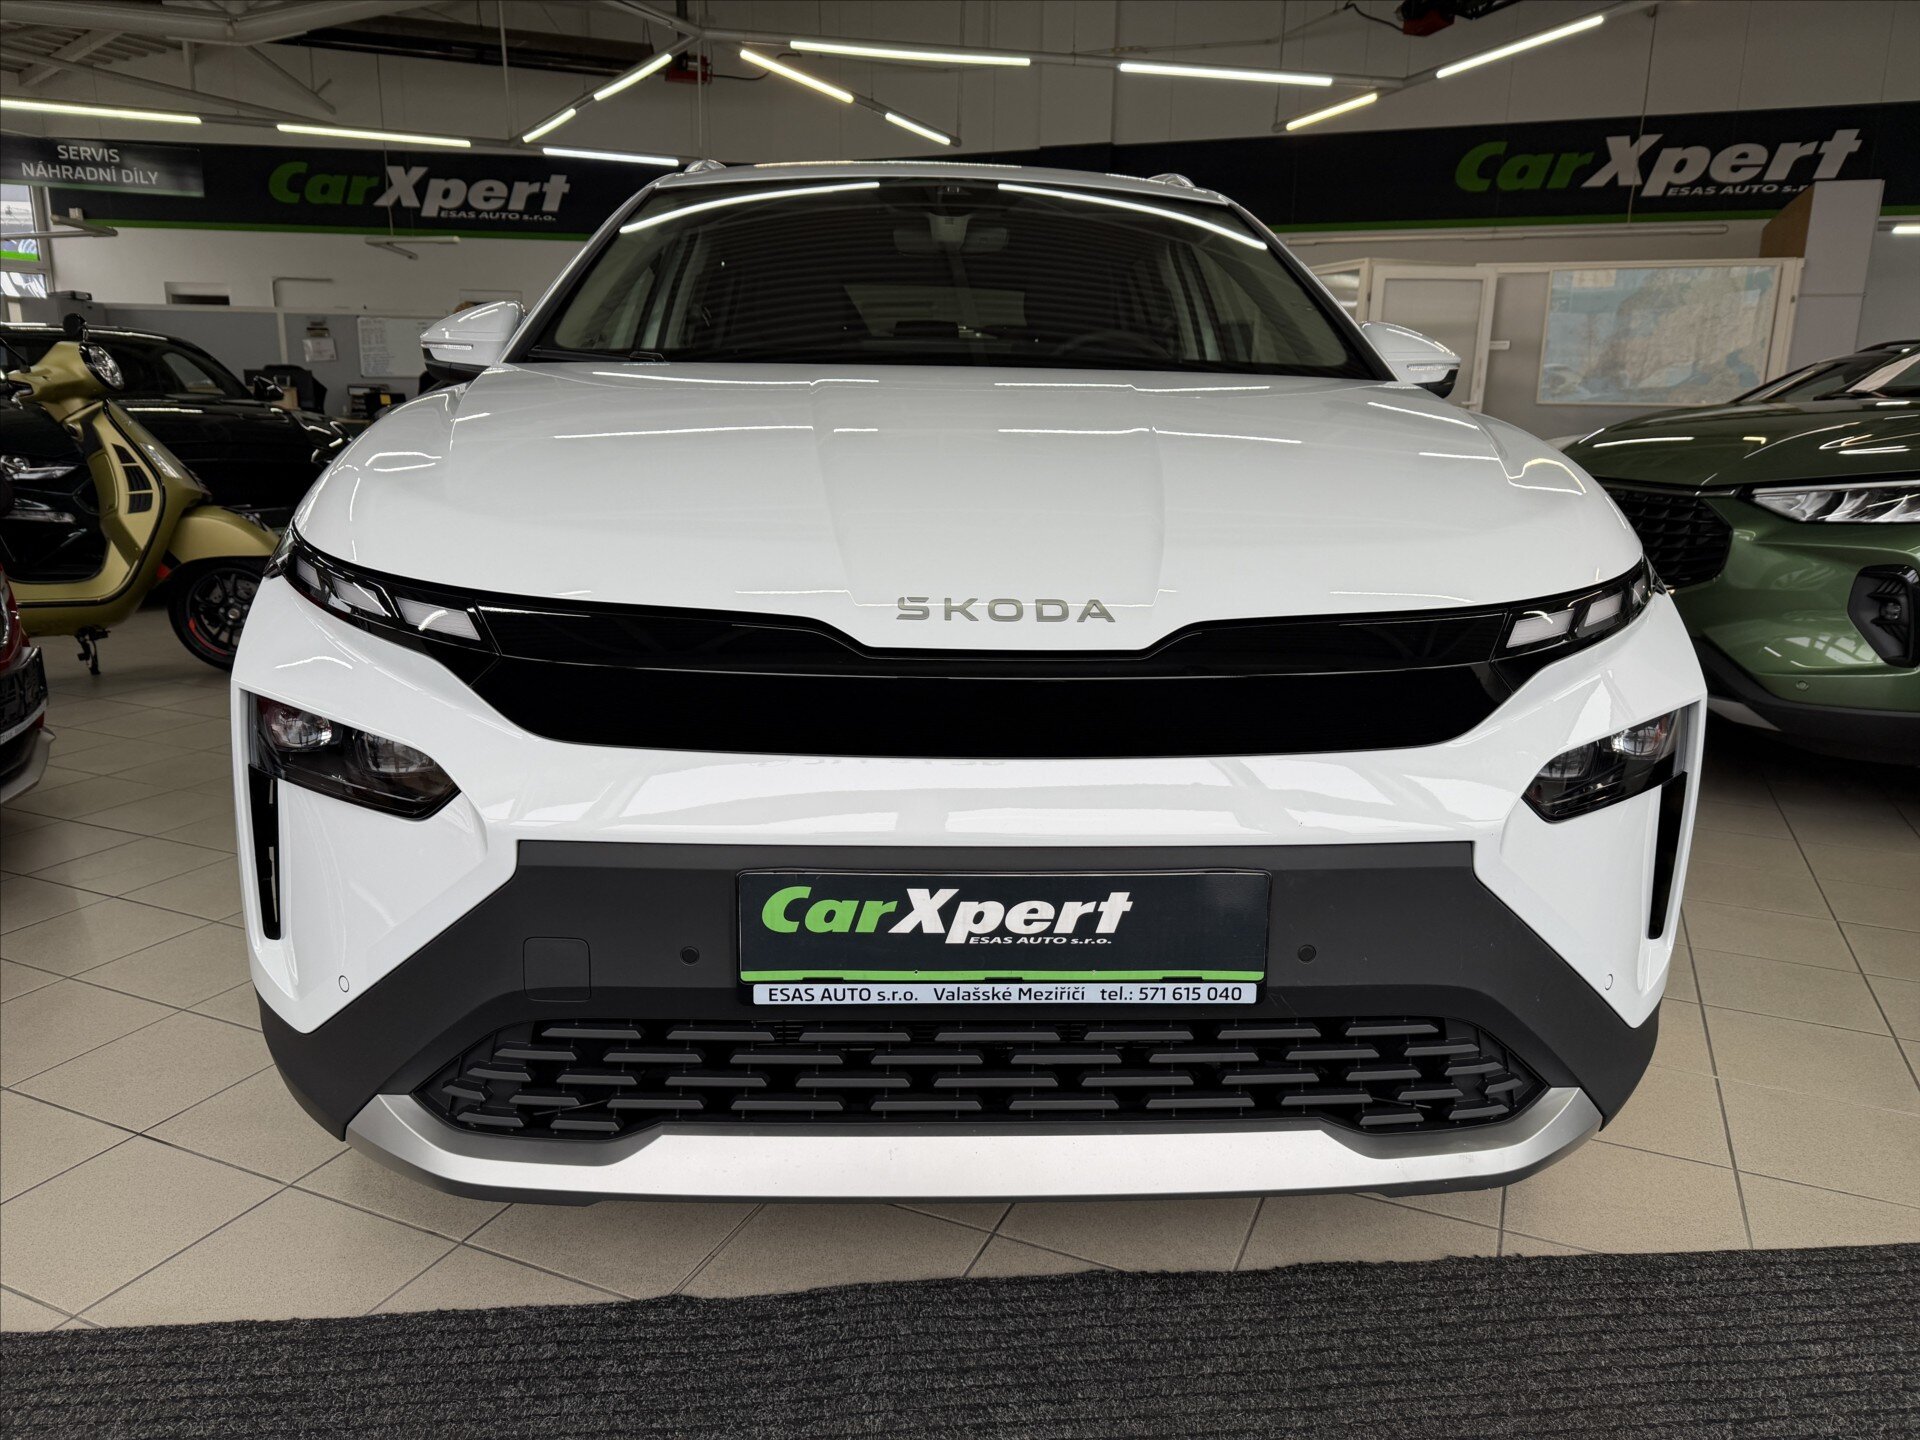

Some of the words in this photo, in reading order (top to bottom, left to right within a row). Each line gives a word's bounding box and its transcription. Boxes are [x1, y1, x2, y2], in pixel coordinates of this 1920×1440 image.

[57, 145, 120, 163] SERVIS
[1454, 128, 1862, 197] CarXpert
[21, 160, 117, 182] NÁHRADNÍ
[121, 167, 158, 185] DÍLY
[268, 161, 571, 217] CarXpert
[1666, 185, 1717, 196] ESAS
[1719, 184, 1779, 195] AUTO
[440, 210, 476, 218] ESAS
[479, 210, 520, 220] AUTO
[522, 213, 556, 221] s.r.o.
[761, 886, 1133, 945] CarXpert
[969, 936, 1013, 944] ESAS
[1016, 936, 1067, 945] AUTO
[1070, 937, 1112, 945] s.r.o.
[768, 987, 815, 1002] ESAS
[820, 987, 872, 1002] AUTO
[877, 989, 918, 1002] s.r.o.
[933, 986, 1012, 1001] Valašské
[1018, 986, 1085, 1001] Meziříčí
[1100, 987, 1133, 1001] tel.:
[1138, 987, 1167, 1001] 571
[1171, 987, 1201, 1001] 615
[1206, 987, 1243, 1001] 040
